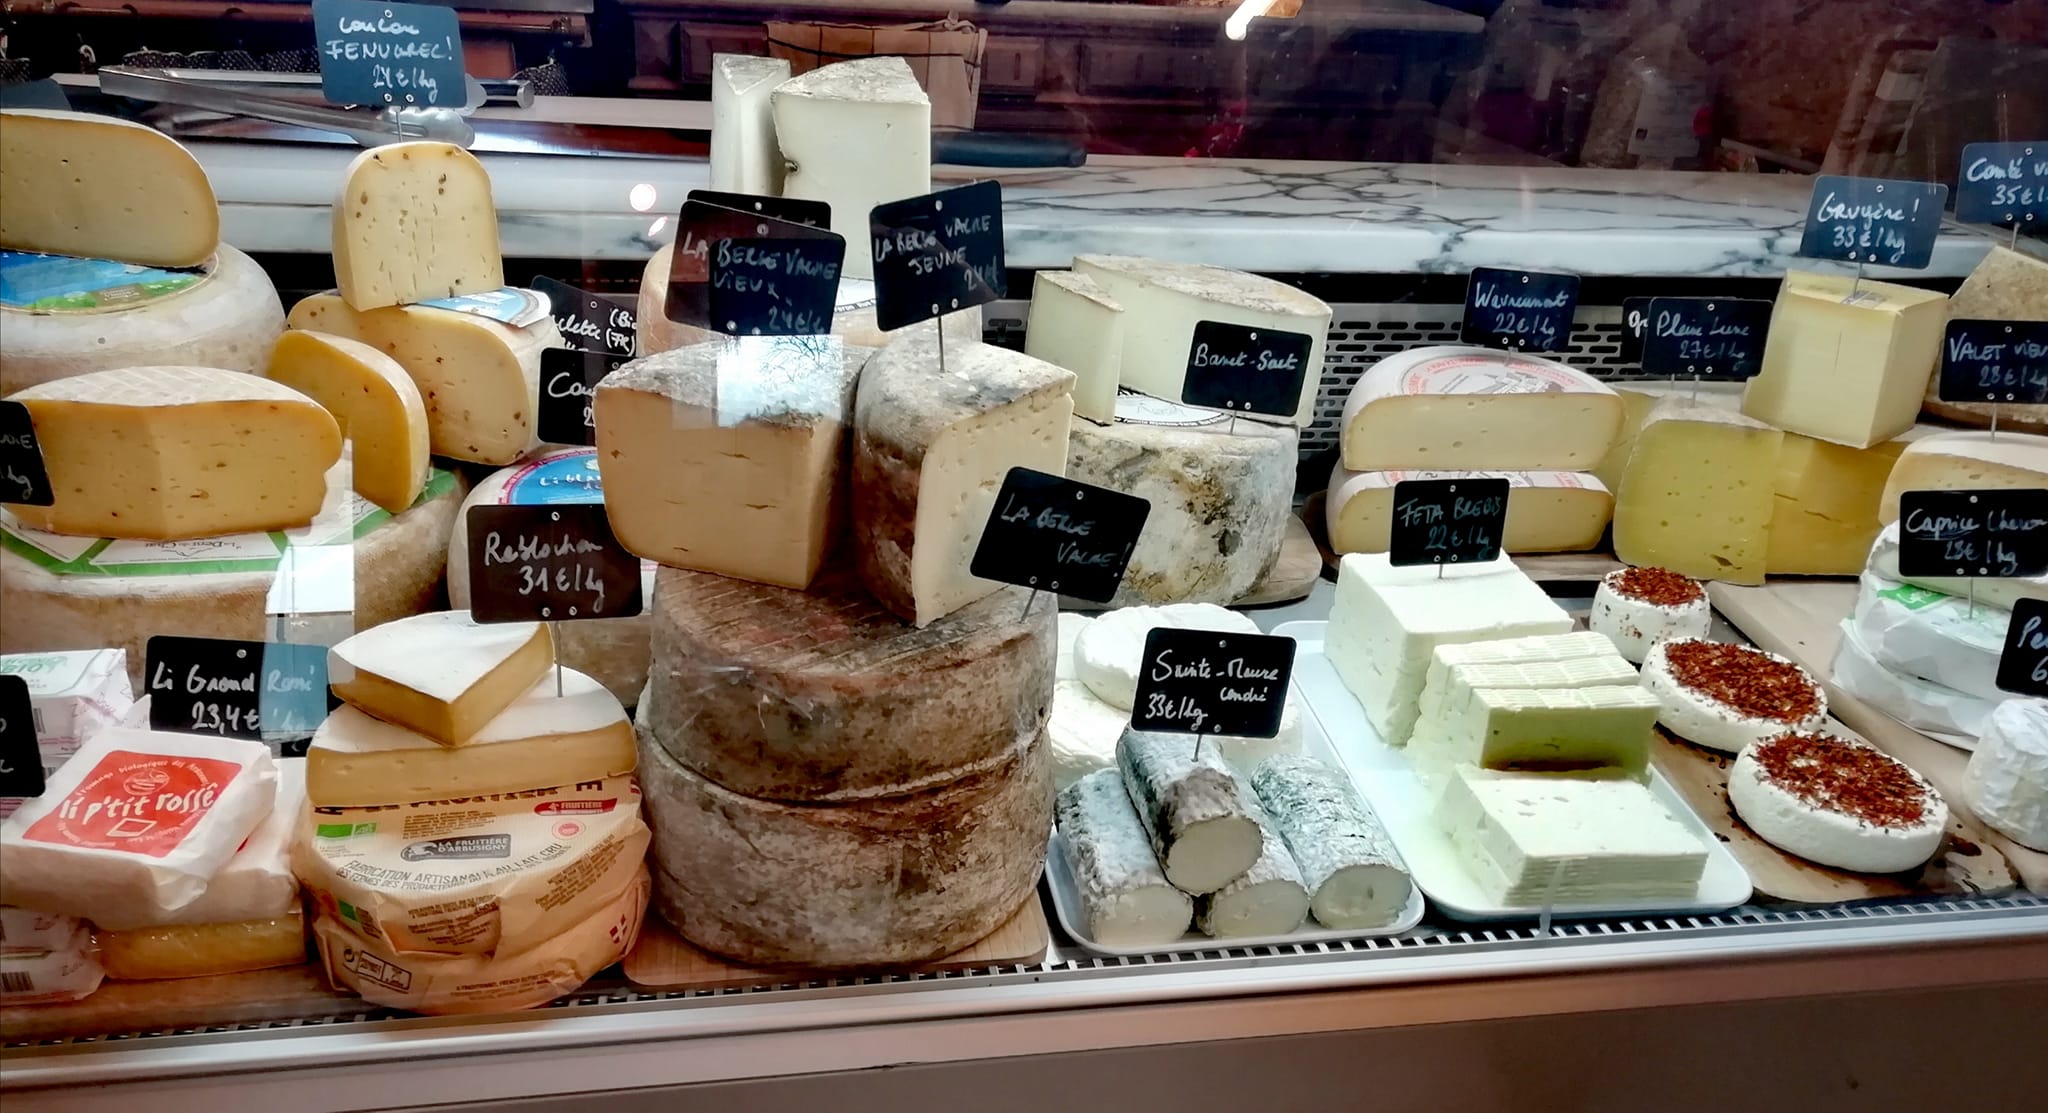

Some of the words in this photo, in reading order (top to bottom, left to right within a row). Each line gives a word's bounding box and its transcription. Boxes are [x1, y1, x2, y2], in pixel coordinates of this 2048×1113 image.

[681, 231, 709, 262] LA
[907, 246, 968, 276] JEUNE
[999, 491, 1031, 523] LA
[1396, 497, 1444, 528] FETA
[343, 859, 414, 882] FABRICATION
